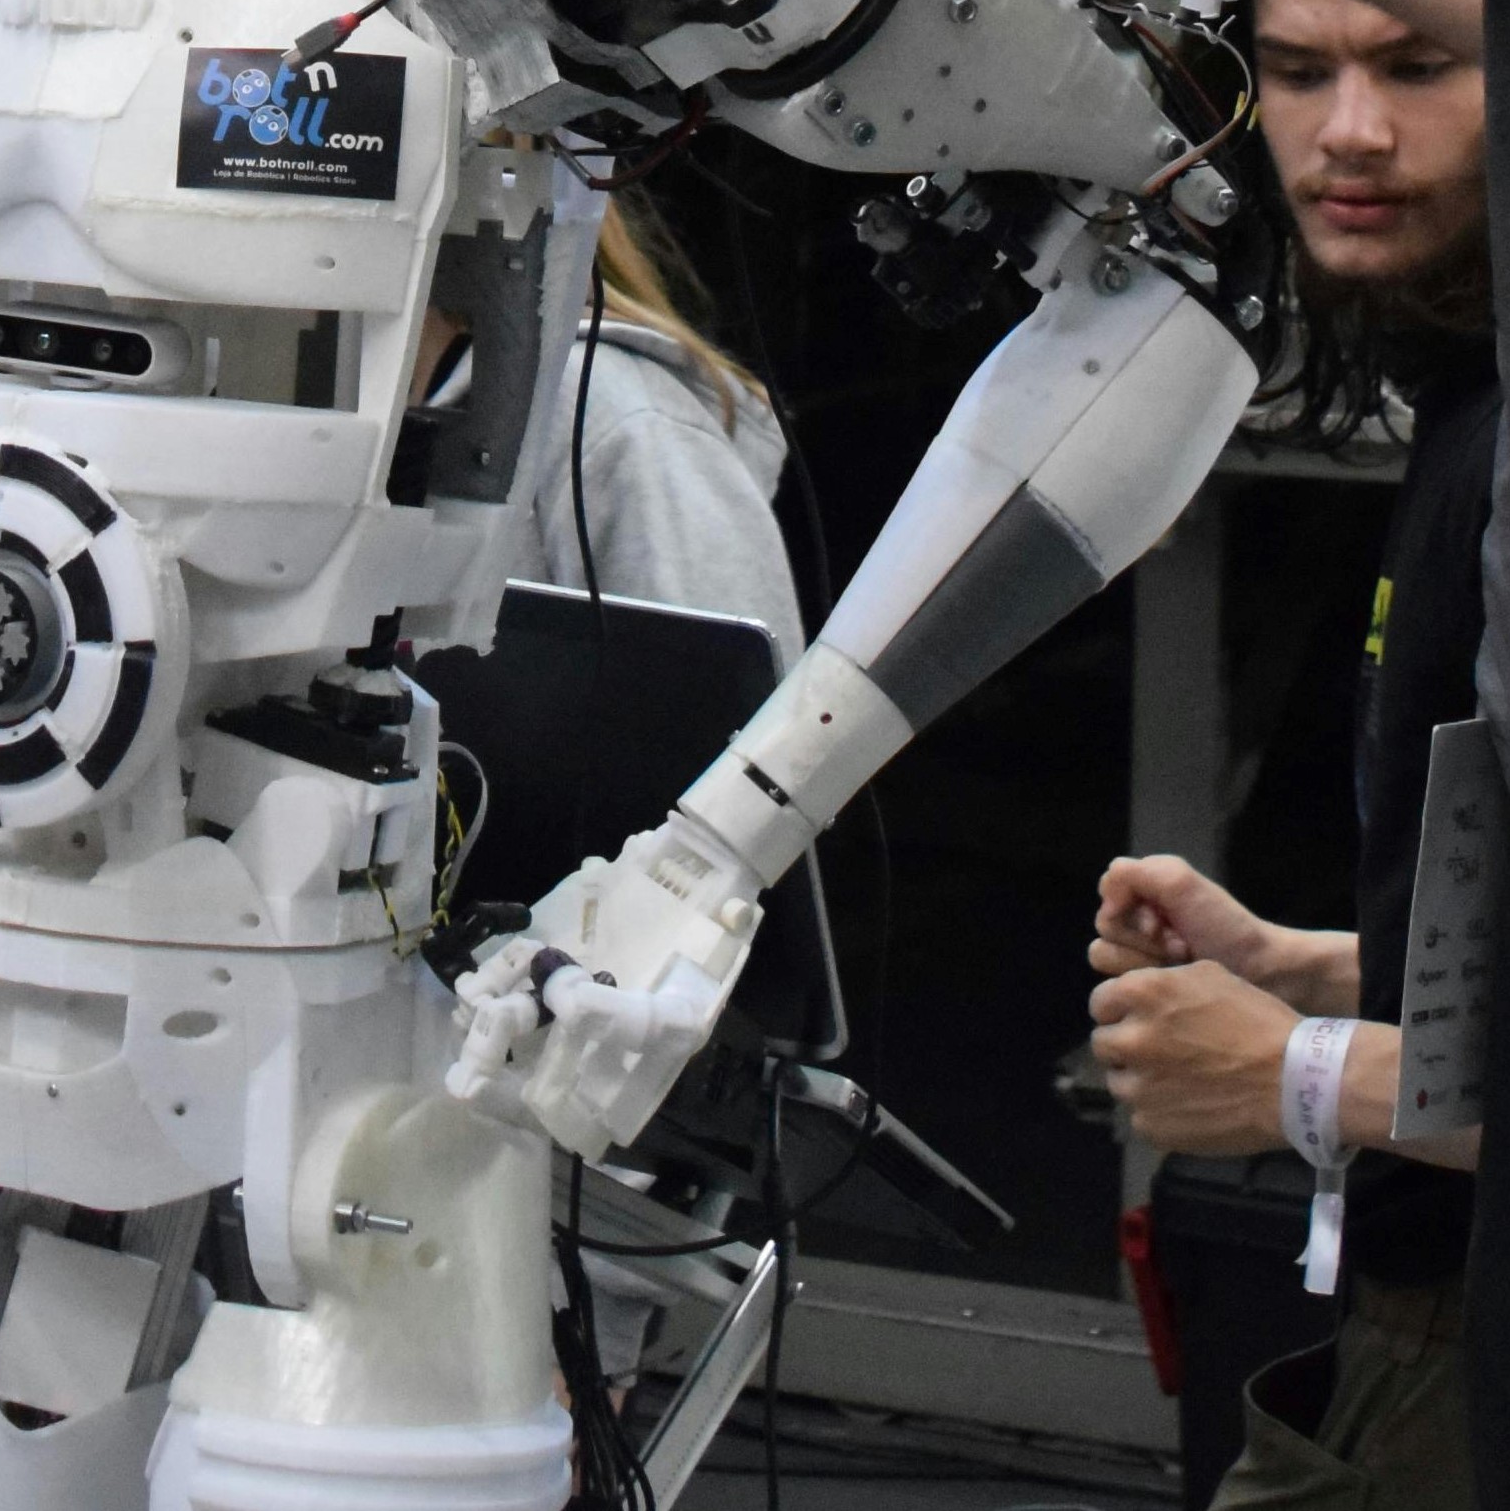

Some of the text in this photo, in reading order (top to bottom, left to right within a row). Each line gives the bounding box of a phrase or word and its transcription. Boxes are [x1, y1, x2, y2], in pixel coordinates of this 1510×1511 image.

[223, 156, 348, 173] www.botnroll.com
[213, 169, 231, 179] Loja
[234, 170, 244, 178] de
[293, 173, 331, 184] Robotics
[333, 176, 357, 185] Store
